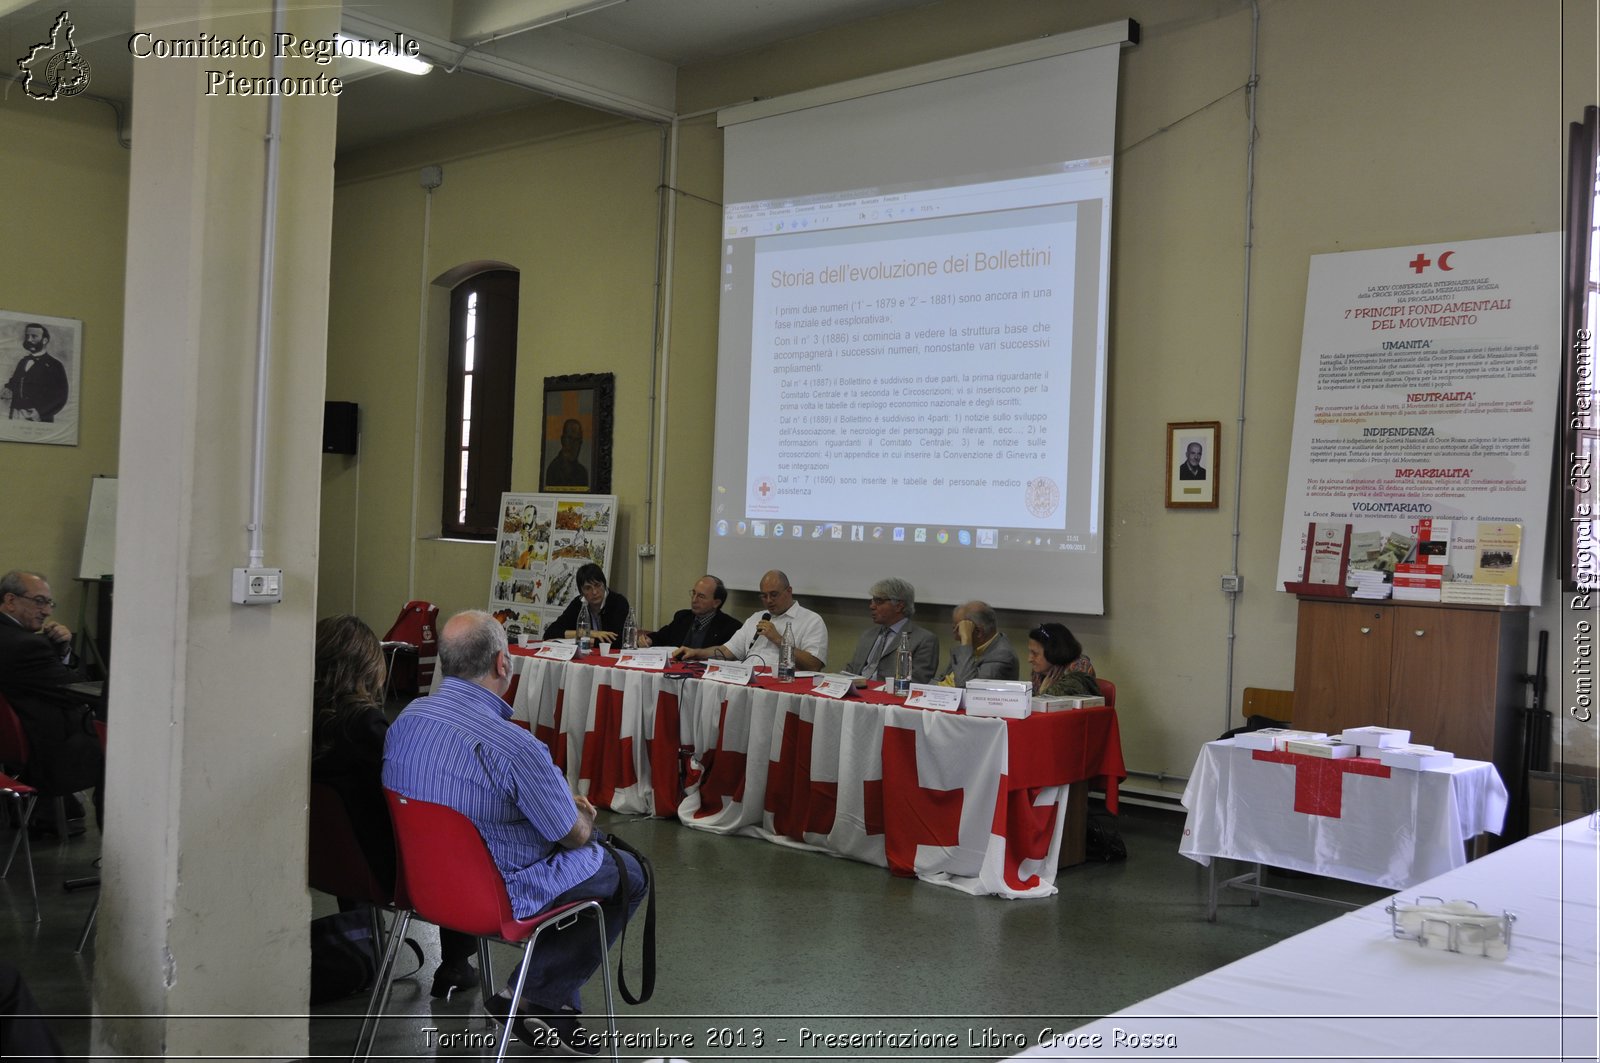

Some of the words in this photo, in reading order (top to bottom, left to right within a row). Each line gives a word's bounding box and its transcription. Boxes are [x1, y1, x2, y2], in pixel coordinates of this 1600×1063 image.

[771, 267, 814, 289] Storia
[942, 252, 969, 274] dei
[974, 245, 1051, 271] Bollettini
[775, 306, 778, 316] I
[780, 304, 799, 317] primi
[802, 303, 817, 314] due
[819, 301, 848, 313] numeri
[875, 297, 896, 309] 1879
[898, 299, 905, 307] e
[930, 292, 955, 307] 1881)
[958, 293, 981, 303] sono
[984, 289, 1017, 301] ancora
[1021, 287, 1030, 298] in
[1033, 288, 1052, 298] una
[1343, 308, 1352, 319] 7
[1354, 305, 1405, 319] PRINCIPI
[1407, 298, 1511, 315] FONDAMENTALI
[774, 319, 792, 330] fase
[793, 317, 819, 329] inziale
[820, 316, 832, 327] ed
[1371, 318, 1396, 330] DEL
[1398, 313, 1478, 329] MOVIMENTO
[774, 335, 790, 346] Con
[793, 335, 798, 345] il
[813, 334, 818, 344] 3
[822, 332, 849, 345] (1886)
[852, 332, 859, 342] si
[862, 329, 901, 341] comincia
[904, 331, 910, 339] a
[914, 327, 945, 338] vedere
[949, 326, 957, 337] la
[961, 323, 1000, 336] struttura
[1004, 322, 1028, 334] base
[1032, 320, 1051, 332] che
[773, 348, 832, 361] accompagnerà
[835, 348, 838, 357] i
[840, 345, 884, 357] successivi
[924, 341, 975, 353] nonostante
[978, 340, 996, 351] vari
[999, 336, 1050, 350] successivi
[1381, 339, 1432, 350] UMANITA'
[1406, 391, 1476, 402] NEUTRALITA'
[1362, 426, 1435, 437] INDIPENDENZA
[1394, 468, 1473, 478] IMPARZIALITA'
[1351, 502, 1432, 512] VOLONTARIATO
